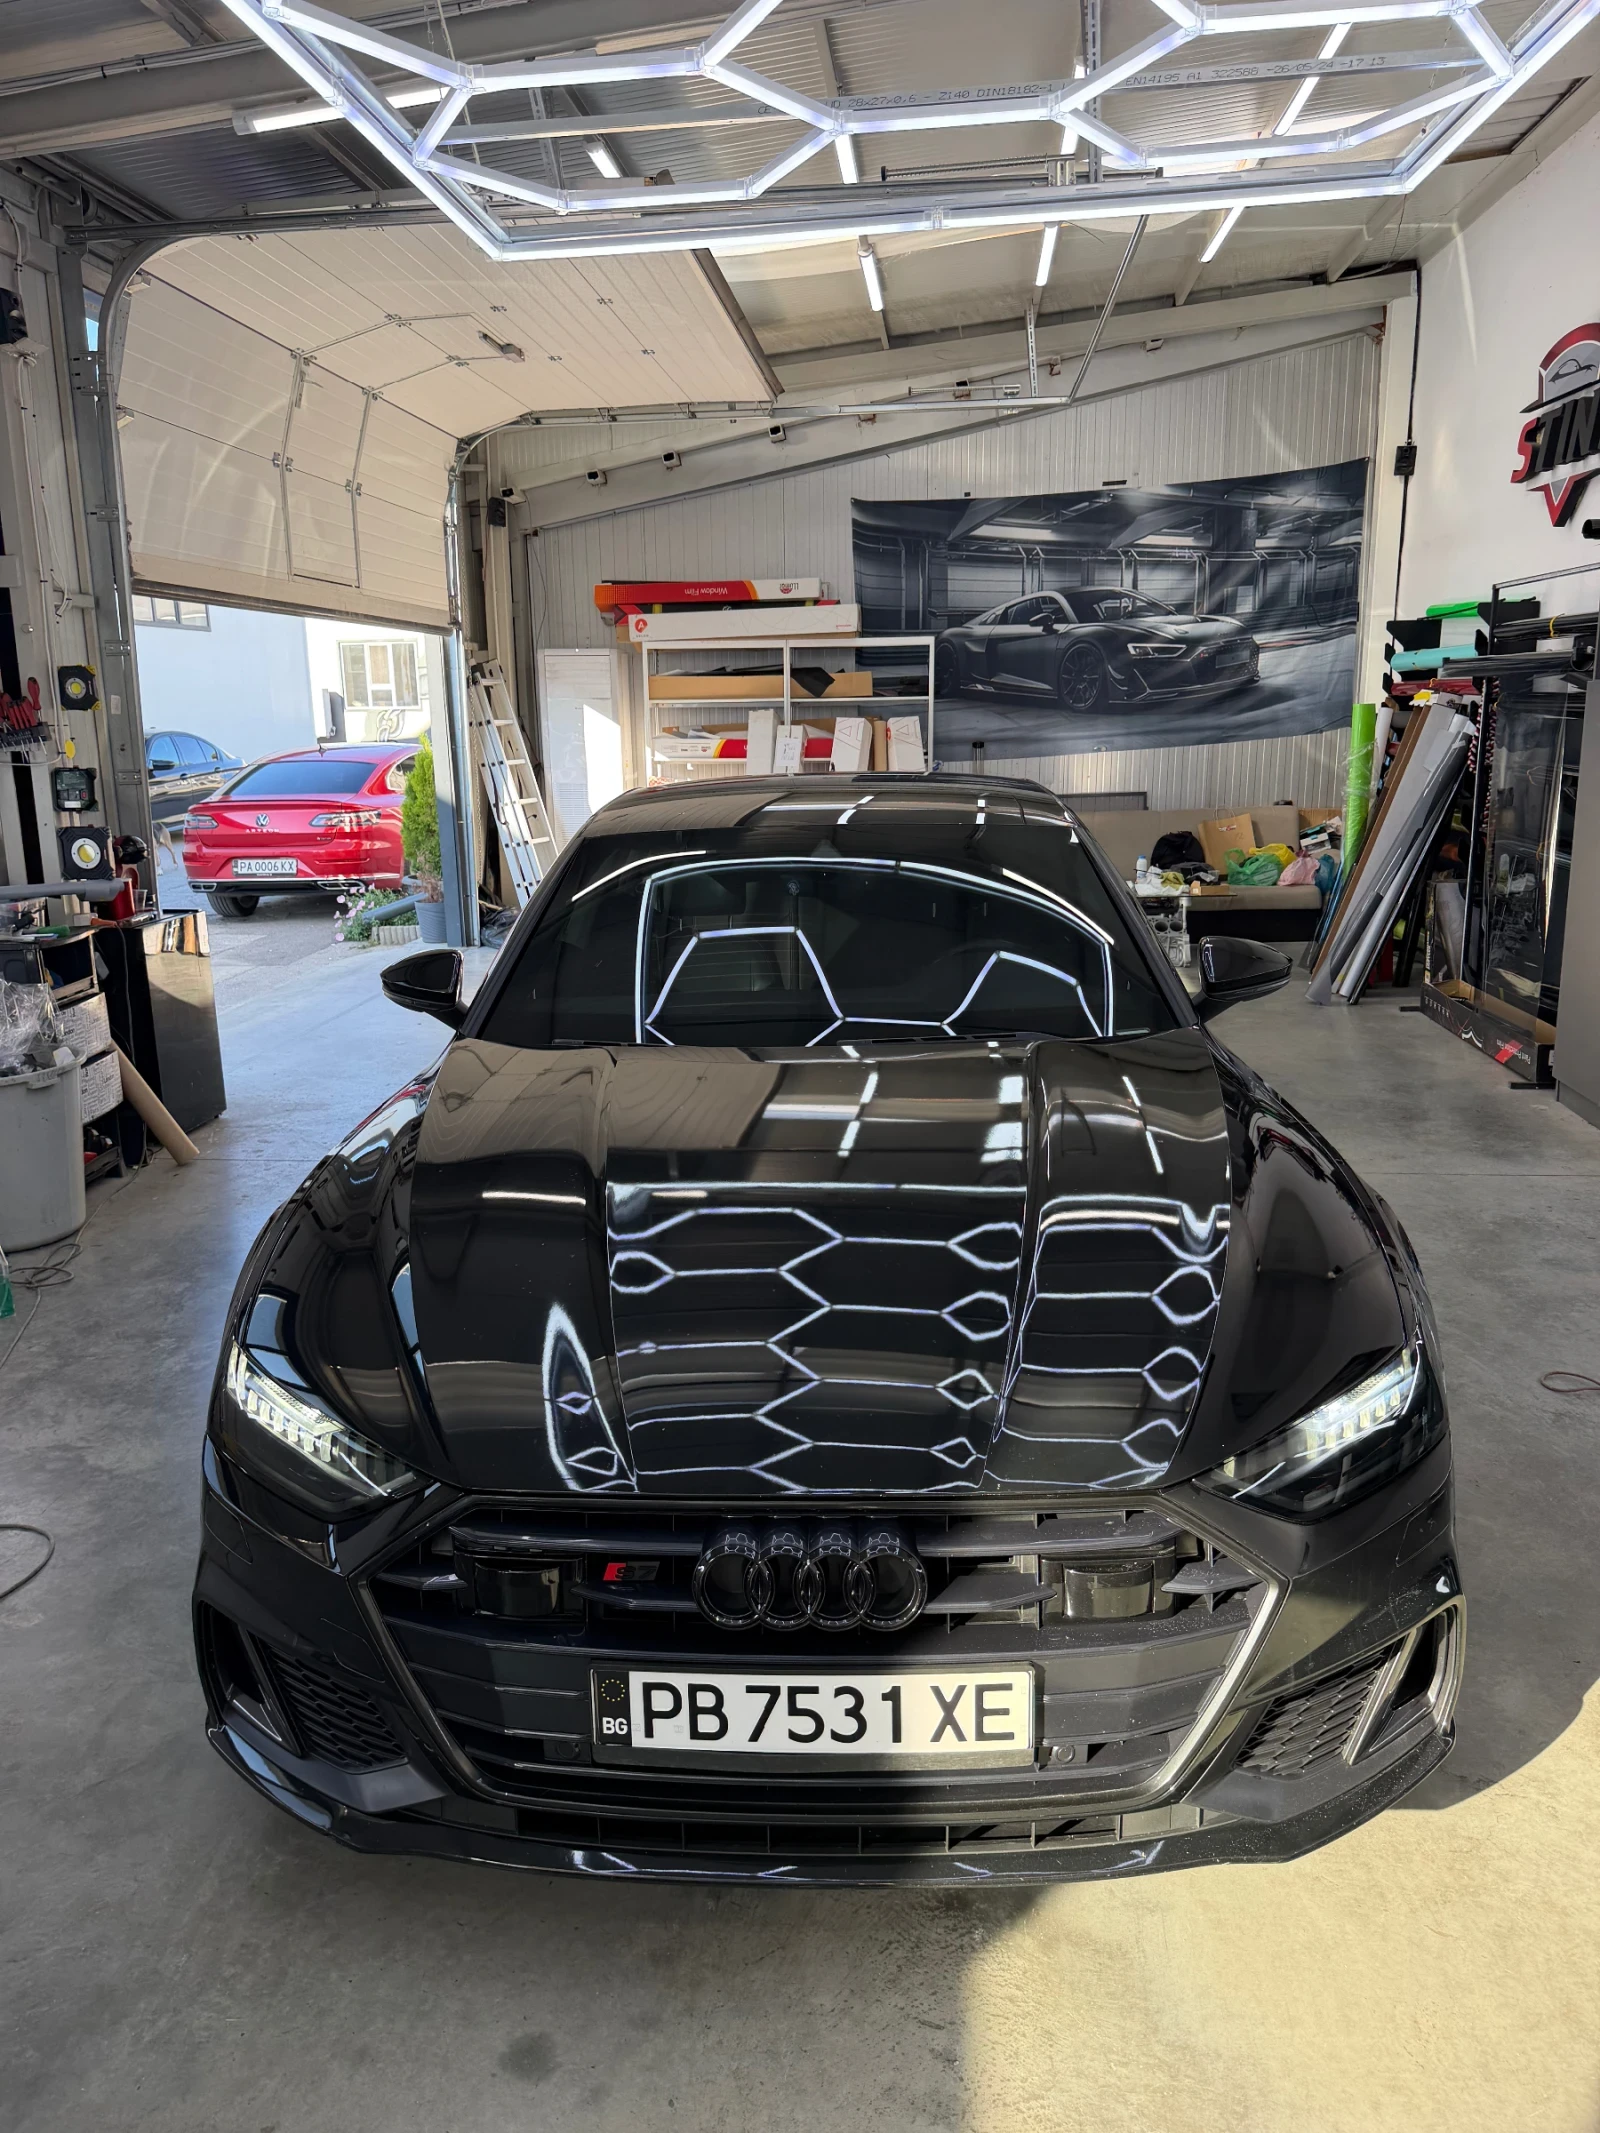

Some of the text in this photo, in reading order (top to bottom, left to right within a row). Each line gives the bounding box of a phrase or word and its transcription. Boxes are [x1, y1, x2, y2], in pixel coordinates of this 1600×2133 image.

[1510, 387, 1600, 484] STIN
[684, 587, 728, 596] Window Film
[240, 861, 295, 872] PA 0006 KX
[614, 1565, 658, 1579] S7
[641, 1681, 1015, 1744] PB 7531 XE
[602, 1717, 628, 1735] BG
